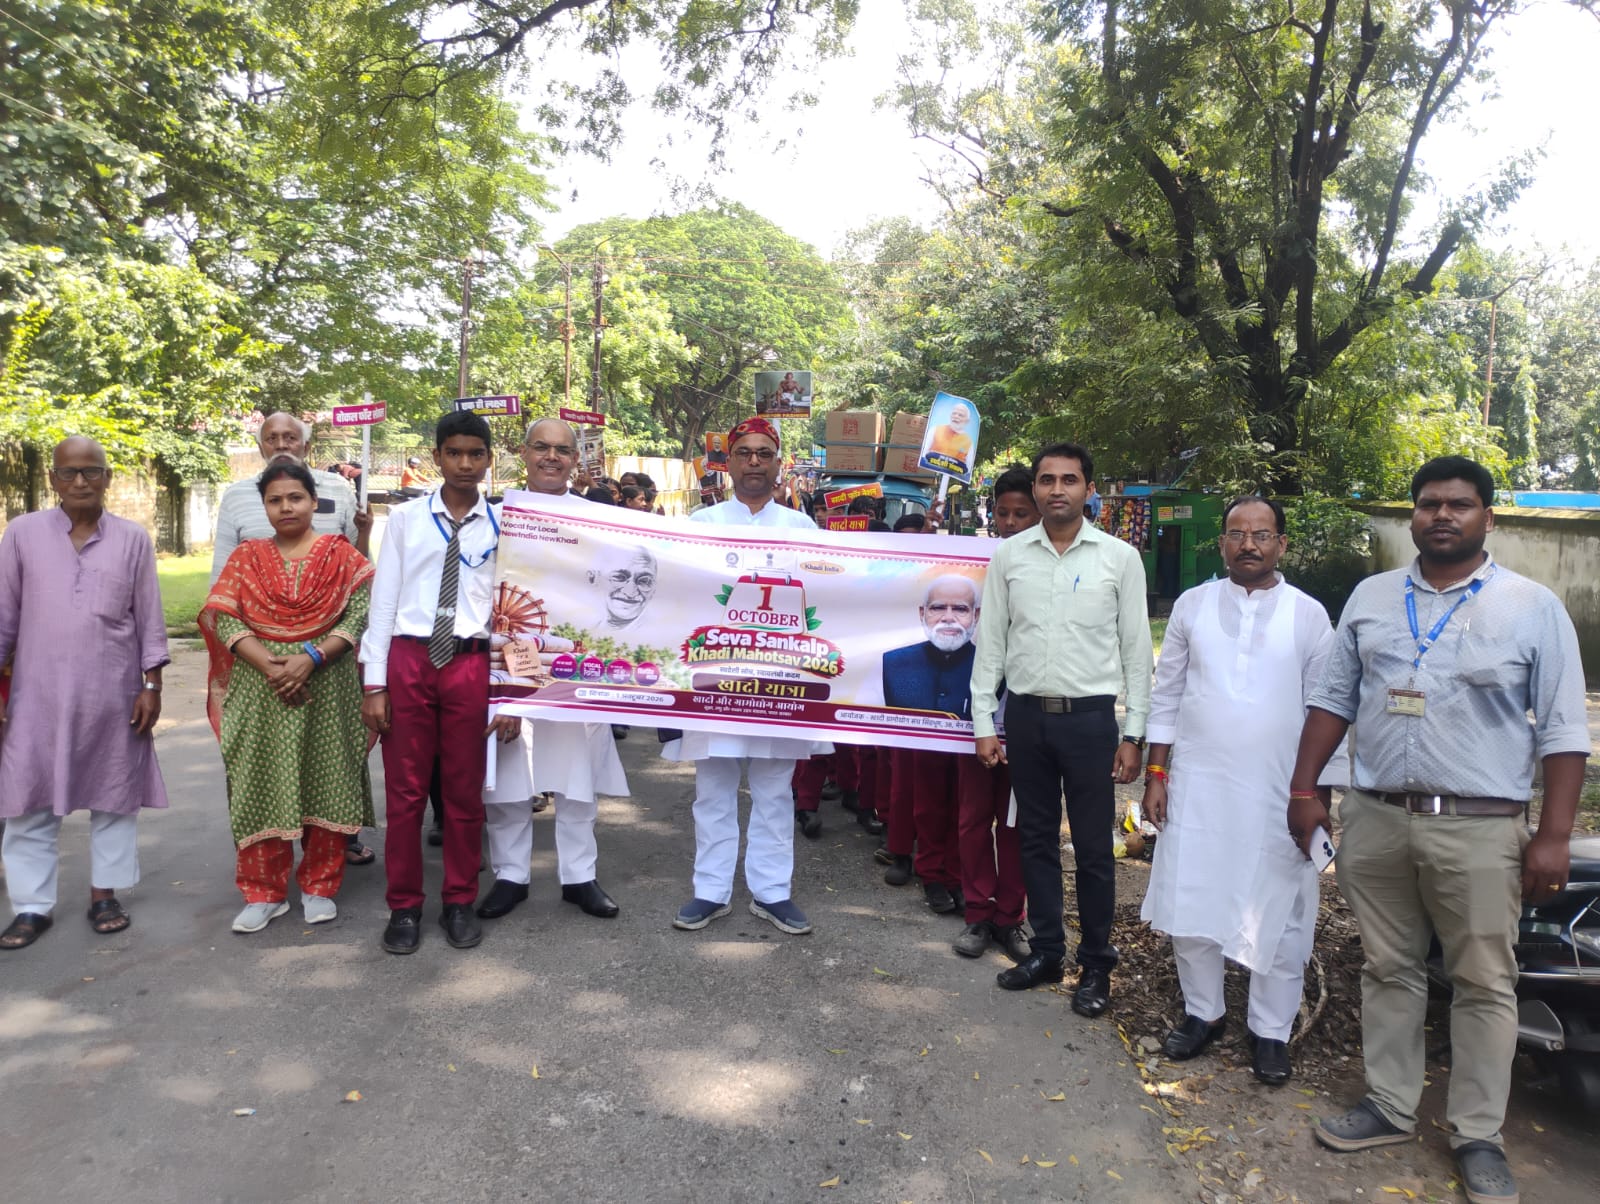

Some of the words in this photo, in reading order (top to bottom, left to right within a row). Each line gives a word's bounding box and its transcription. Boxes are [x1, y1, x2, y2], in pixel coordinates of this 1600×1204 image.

[336, 410, 358, 422] वोकल
[359, 408, 372, 420] फॉर
[500, 530, 538, 540] NewIndia
[804, 563, 824, 571] Khadi
[824, 565, 840, 573] India
[757, 585, 773, 611] 1
[728, 609, 799, 627] OCTOBER
[706, 628, 752, 646] Seva
[755, 632, 829, 657] Sankalp
[687, 647, 731, 662] Khadi
[732, 649, 801, 666] Mahotsav
[802, 655, 839, 675] 2026
[718, 678, 760, 694] खादी
[765, 683, 806, 698] यात्रा
[692, 695, 714, 705] खादी
[716, 696, 732, 706] और
[775, 700, 805, 712] आयोग
